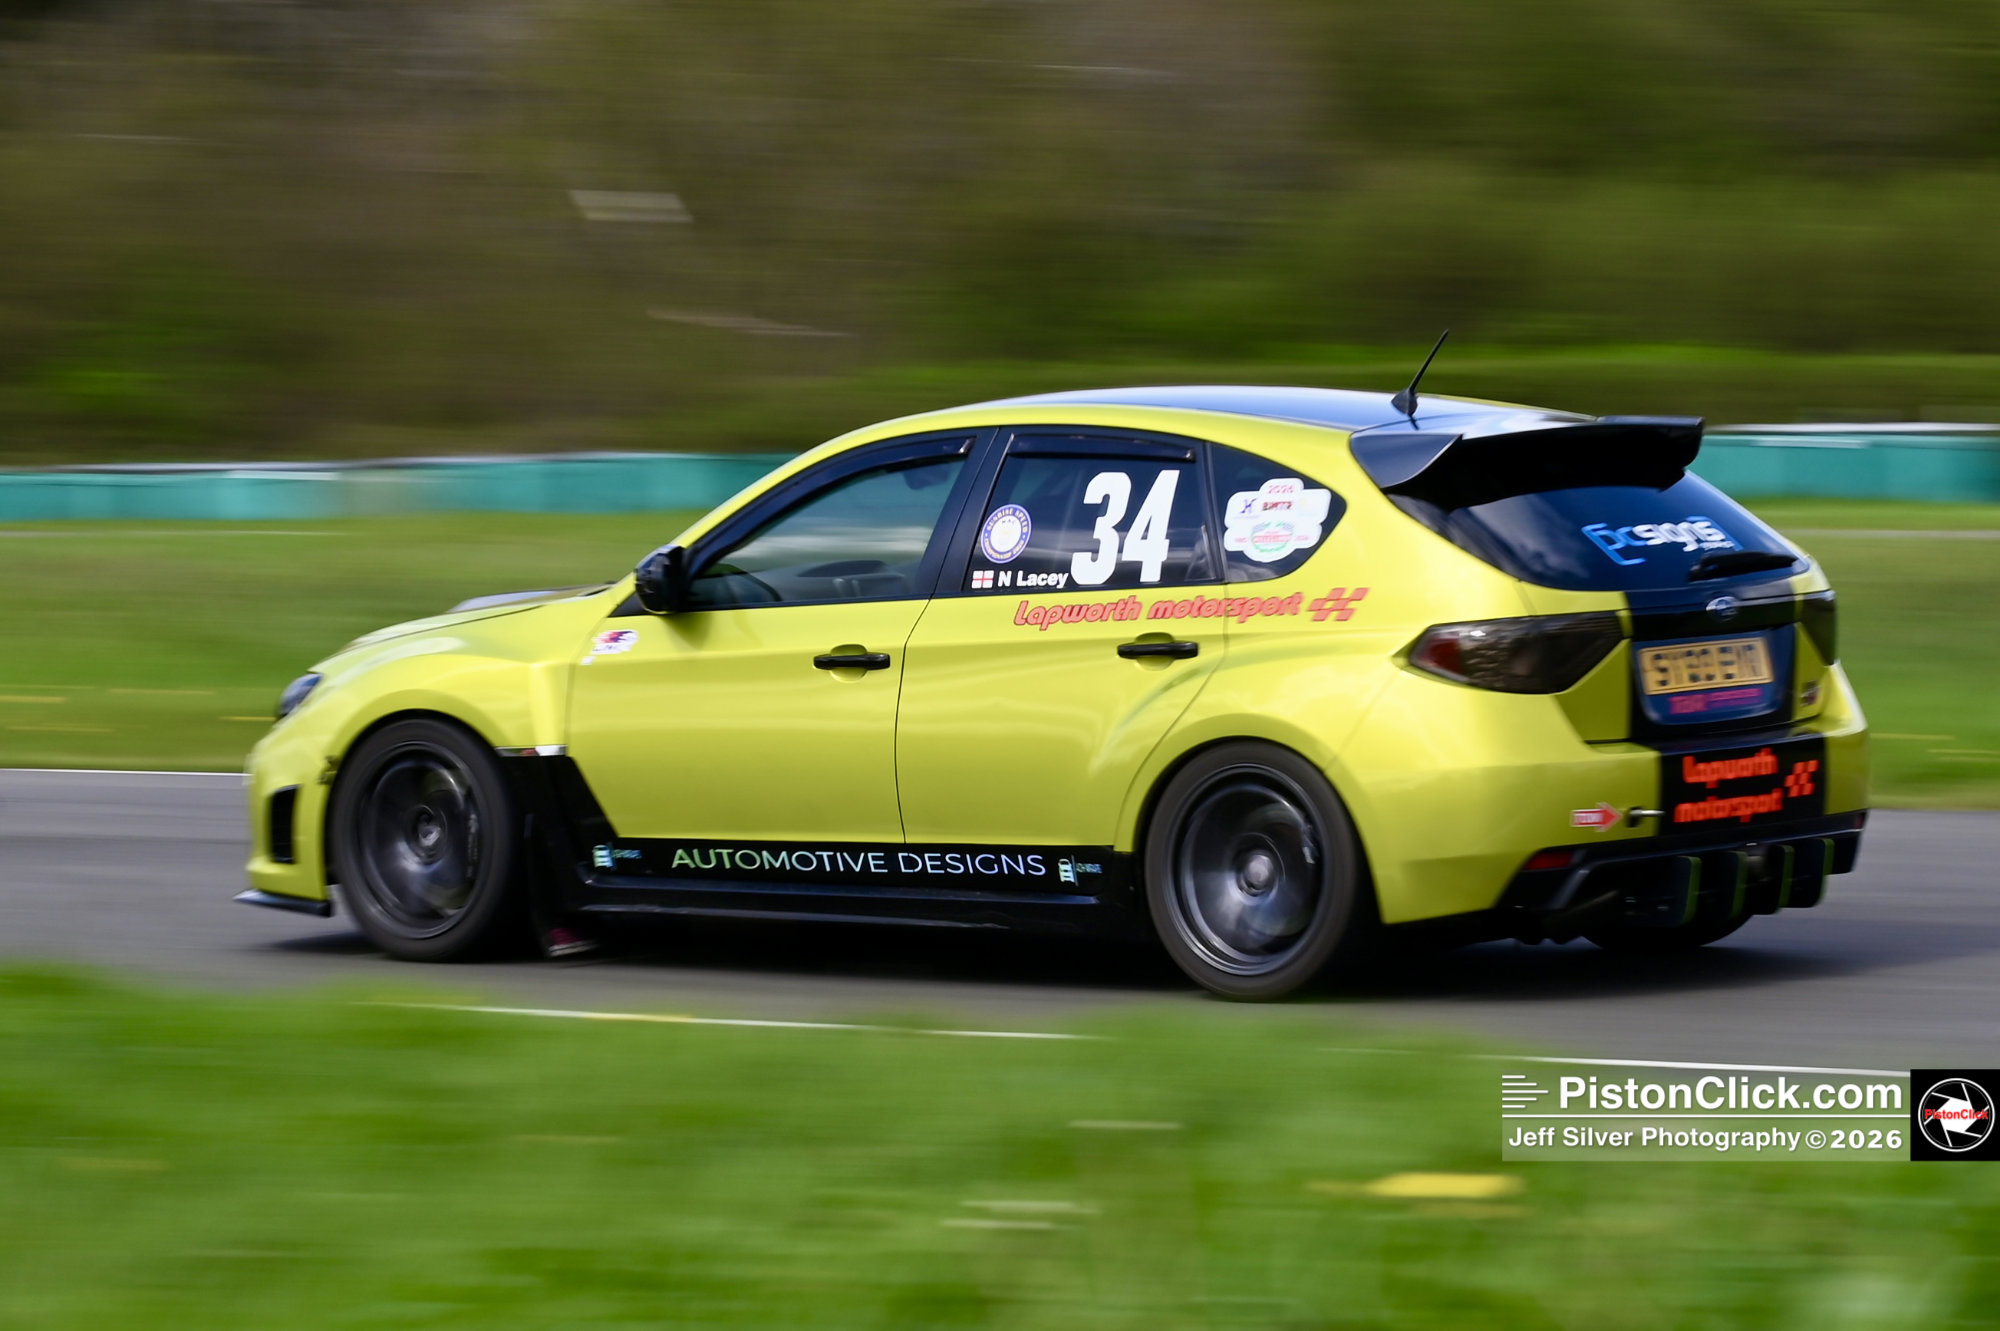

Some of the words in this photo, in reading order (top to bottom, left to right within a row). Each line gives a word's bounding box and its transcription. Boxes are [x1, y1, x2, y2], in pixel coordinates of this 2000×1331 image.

[1014, 508, 1029, 533] SPEED
[1071, 470, 1180, 585] 34
[997, 570, 1012, 587] N
[1016, 570, 1069, 589] Lacey
[1014, 595, 1142, 631] Lapworth
[1147, 592, 1302, 623] motorsport
[1673, 788, 1784, 824] motorsport
[671, 848, 888, 873] AUTOMOTIVE
[898, 852, 1047, 877] DESIGNS
